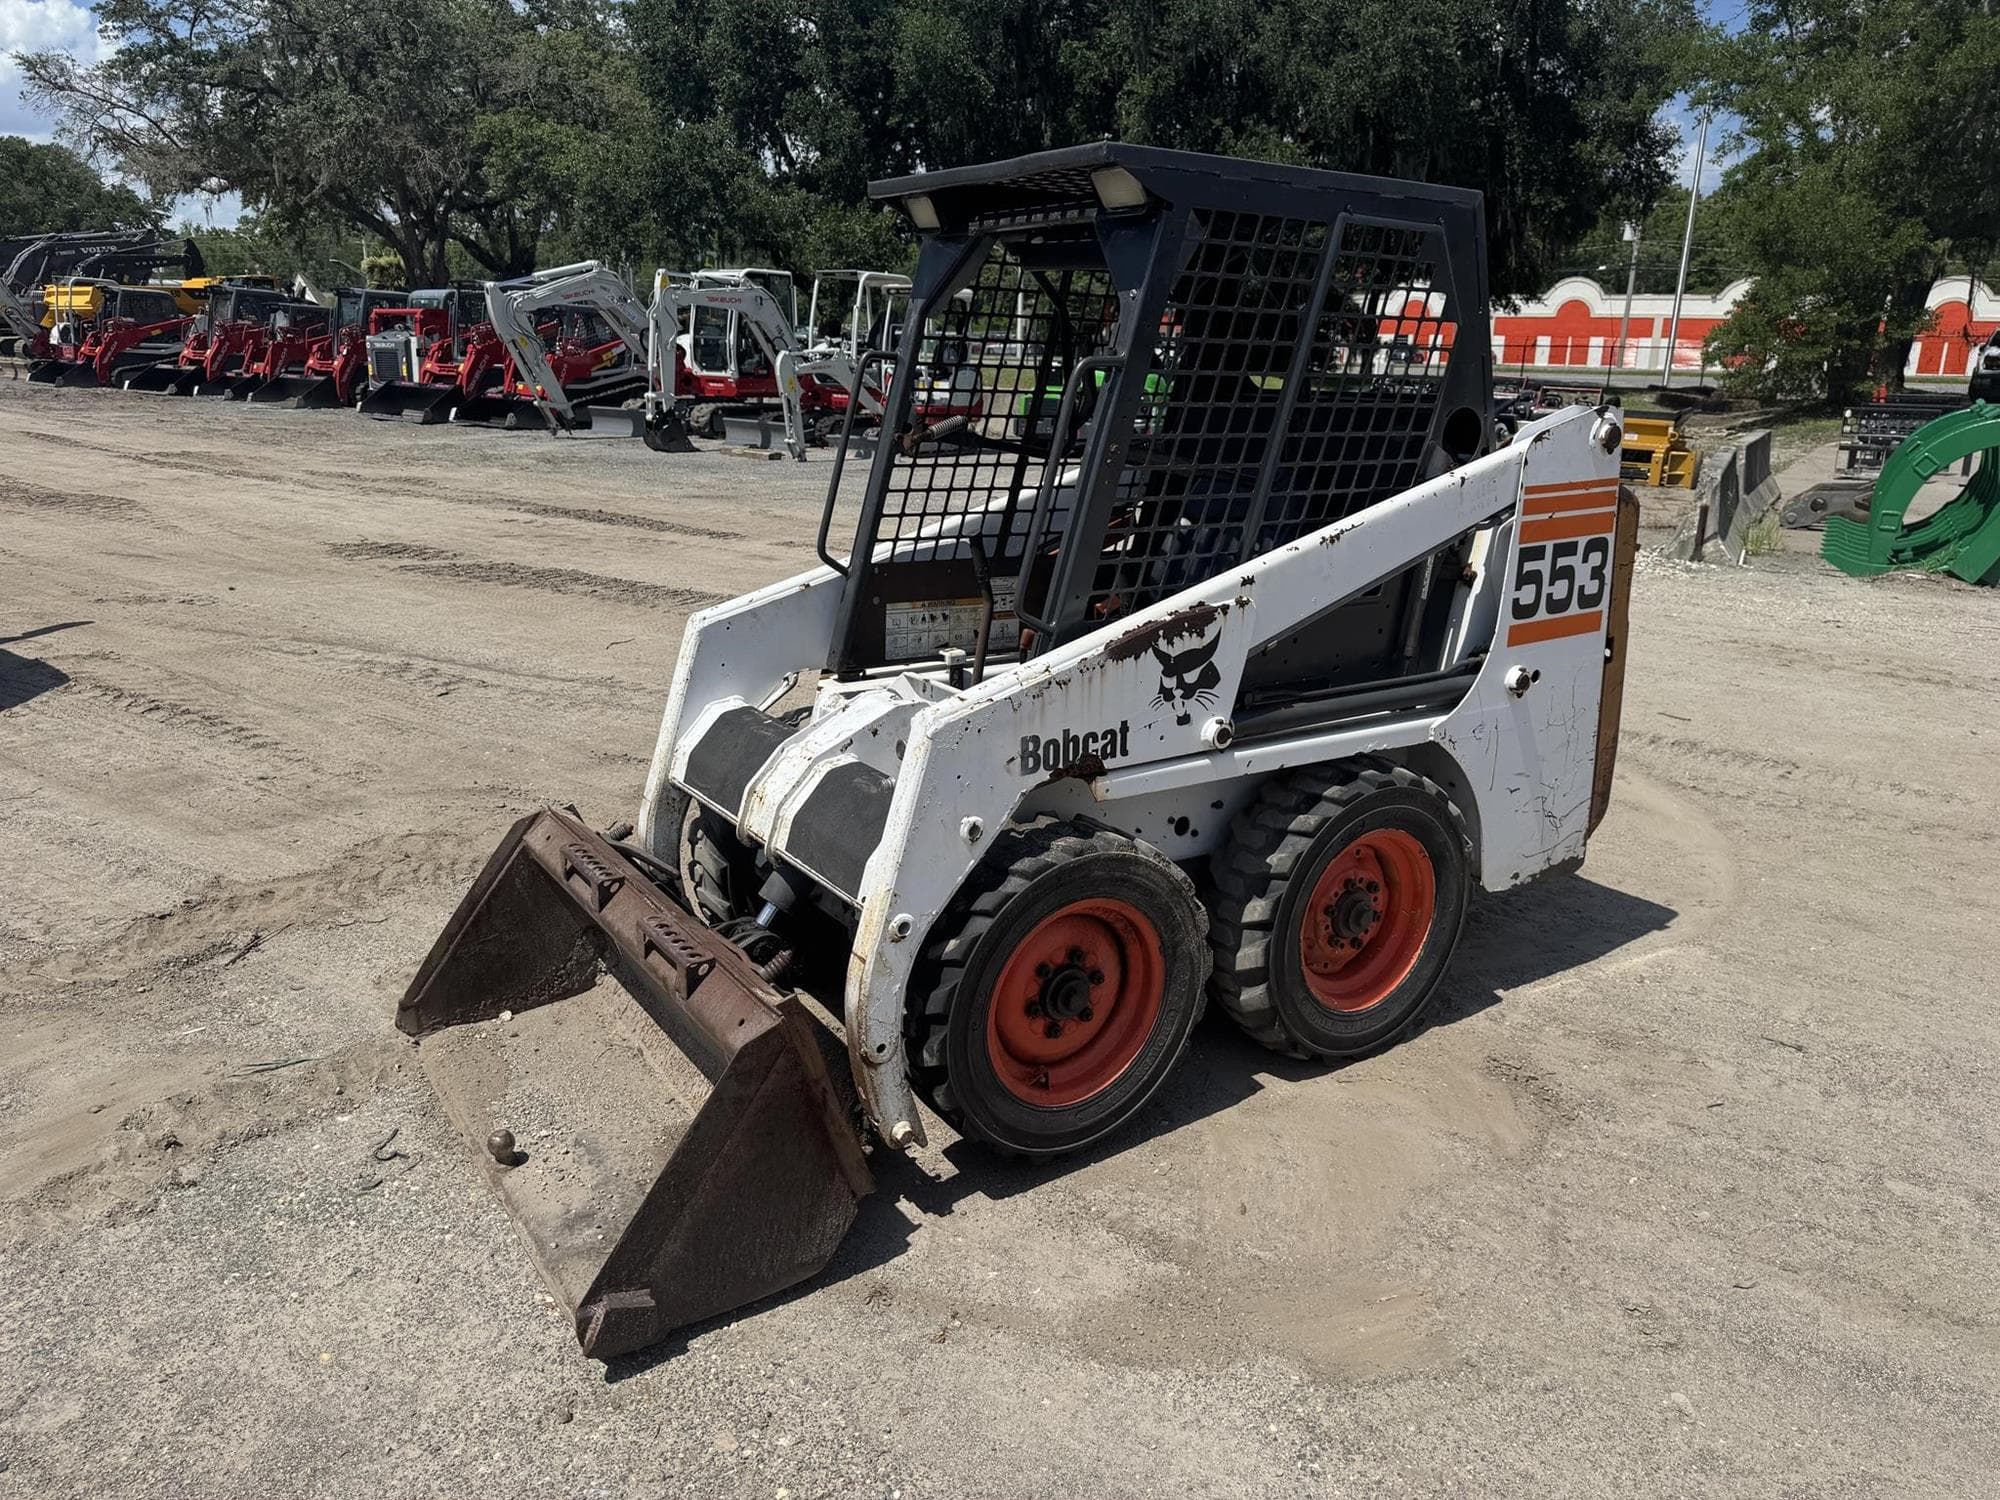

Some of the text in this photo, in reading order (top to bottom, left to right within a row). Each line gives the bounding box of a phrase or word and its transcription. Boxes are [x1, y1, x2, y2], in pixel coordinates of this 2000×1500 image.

[80, 245, 117, 255] VOLVO
[560, 288, 595, 300] TAKEUCHI
[706, 295, 742, 304] TAKEUCHI
[1512, 536, 1609, 621] 553
[1020, 720, 1130, 776] Bobcat
